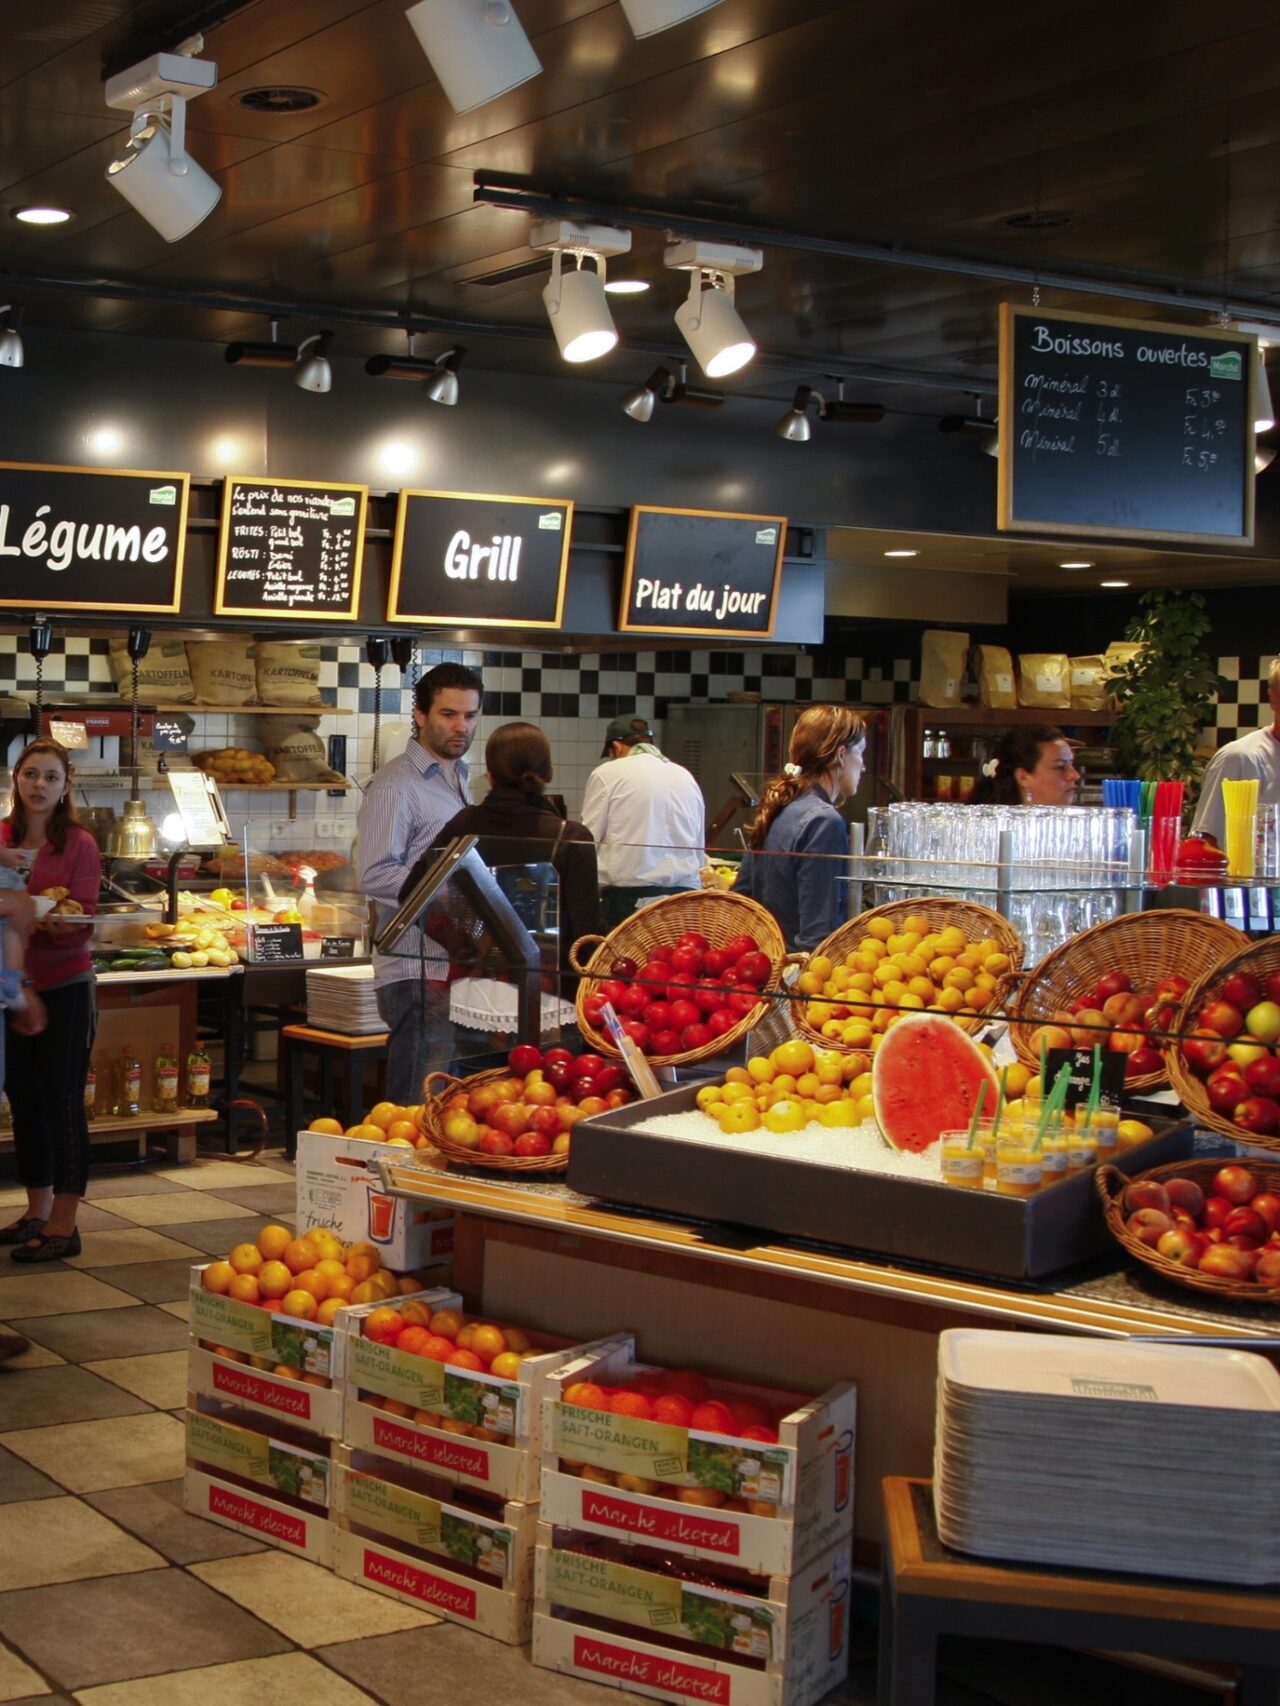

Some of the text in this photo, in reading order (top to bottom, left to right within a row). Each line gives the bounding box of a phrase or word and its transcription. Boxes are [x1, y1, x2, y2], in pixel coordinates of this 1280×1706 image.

[1031, 326, 1124, 358] Boissons
[247, 490, 269, 505] prix
[271, 488, 284, 503] de
[287, 495, 303, 503] nos
[444, 531, 522, 581] Grill
[636, 578, 766, 620] Plat du jour
[139, 669, 192, 680] ARTOFFELN
[217, 1374, 305, 1412] Marché selected
[562, 1406, 612, 1427] FRISCHE
[379, 1429, 482, 1472] Marché selected
[561, 1421, 660, 1452] SAFT-ORANGEN
[214, 1497, 300, 1540] Marché selected
[589, 1503, 657, 1532] Marché
[555, 1554, 608, 1575] FRISCHE
[369, 1562, 470, 1611] Marché selected
[555, 1567, 654, 1601] SAFT-ORANGEN
[582, 1649, 722, 1698] Marché selected
